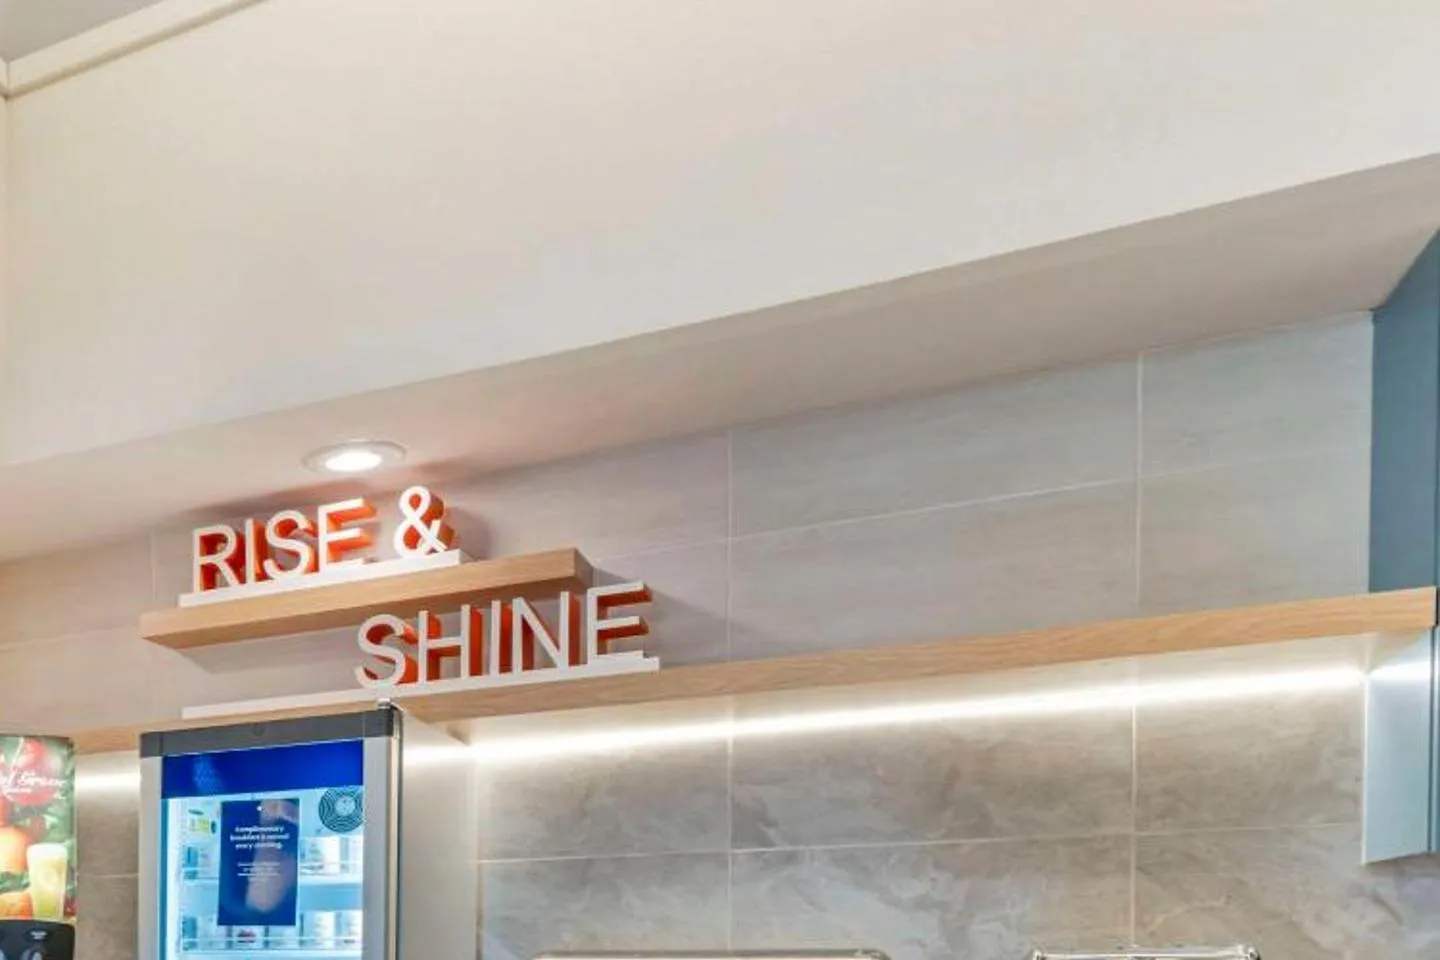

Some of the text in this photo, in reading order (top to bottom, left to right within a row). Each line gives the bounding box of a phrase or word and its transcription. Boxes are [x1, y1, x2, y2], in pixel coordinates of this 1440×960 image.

[192, 485, 453, 594] RISE &
[354, 582, 650, 688] SHINE
